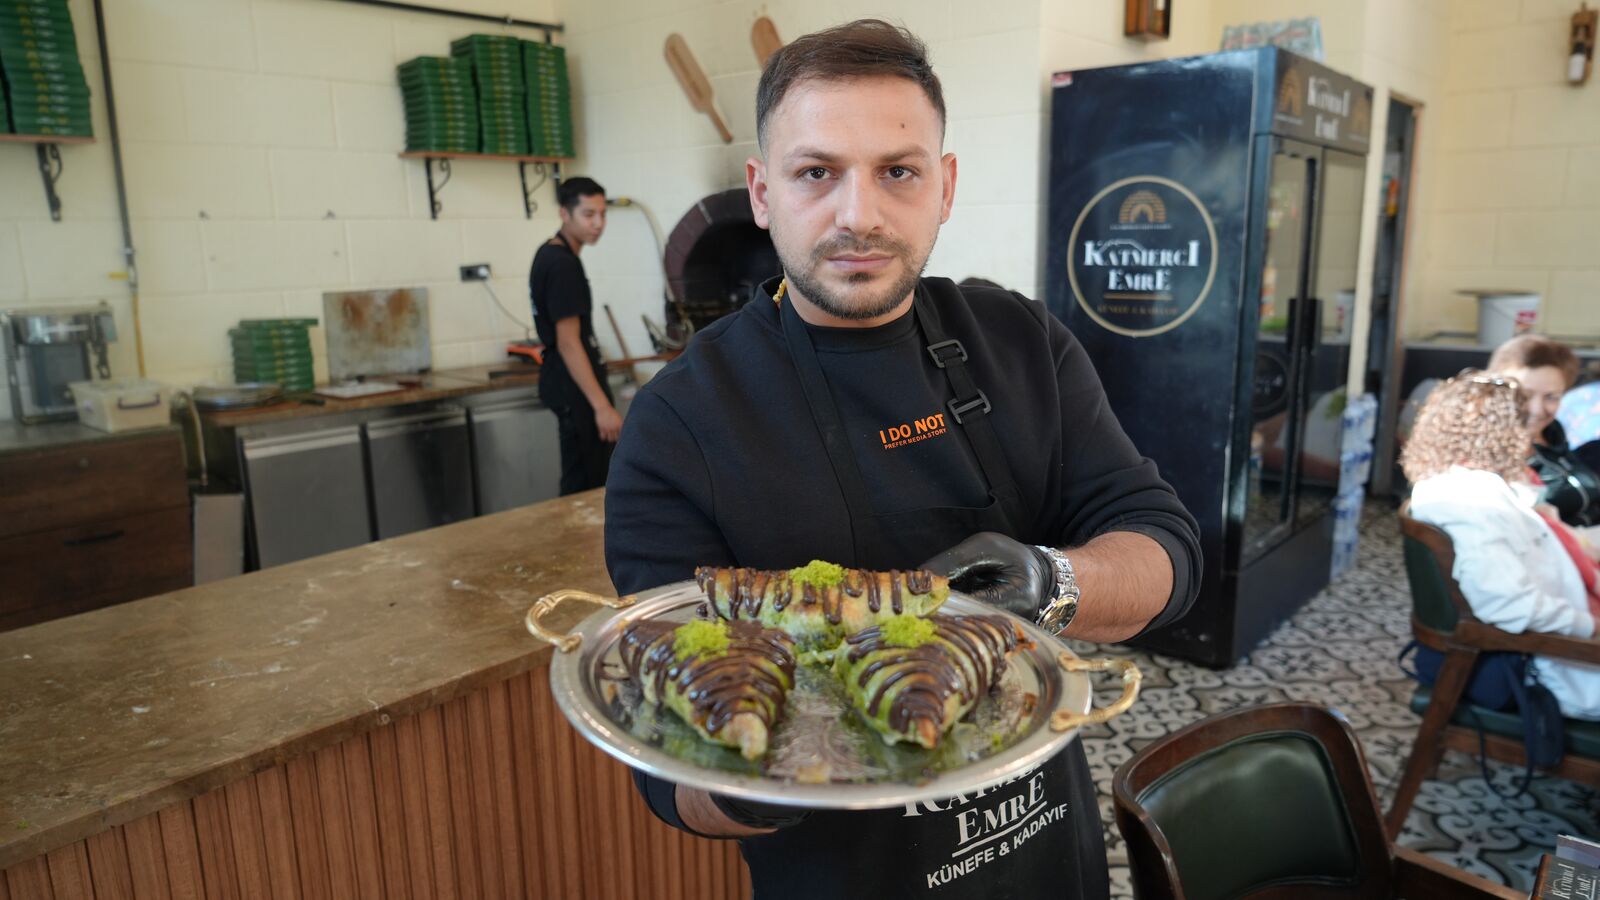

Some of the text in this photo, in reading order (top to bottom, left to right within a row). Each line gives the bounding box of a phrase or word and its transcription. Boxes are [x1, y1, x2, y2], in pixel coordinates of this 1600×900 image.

[1108, 269, 1171, 290] EMRE
[880, 413, 945, 444] I DO NOT
[884, 428, 947, 450] PREFER MEDIA STORY
[955, 771, 1045, 846] EMRE
[926, 803, 1068, 889] KÜNEFE & KADAYIF
